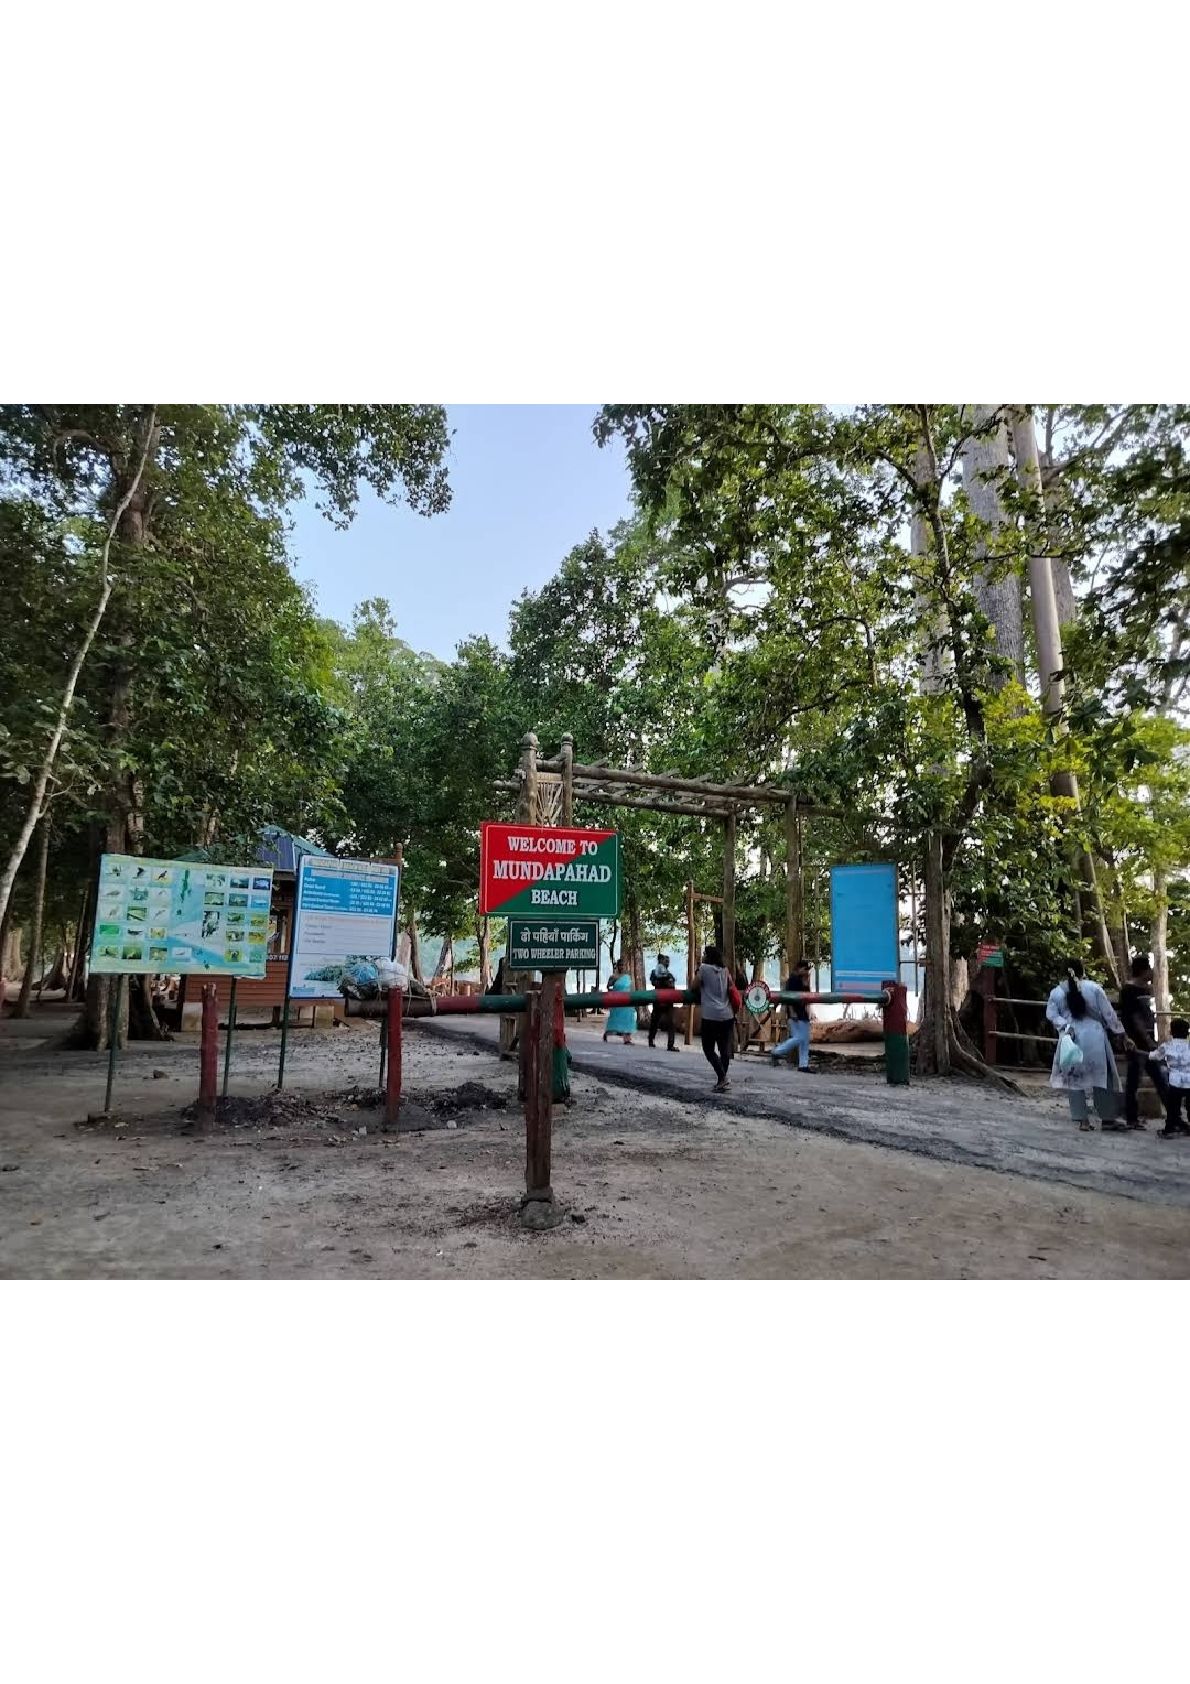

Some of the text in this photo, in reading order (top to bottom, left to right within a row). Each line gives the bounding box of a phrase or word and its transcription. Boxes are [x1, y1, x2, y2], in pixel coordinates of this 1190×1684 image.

[507, 836, 598, 856] WELCOME TO
[493, 860, 611, 883] MUNDAPAHAD
[531, 889, 577, 905] BEACH
[512, 948, 596, 959] TWO WHEELER PARKING
